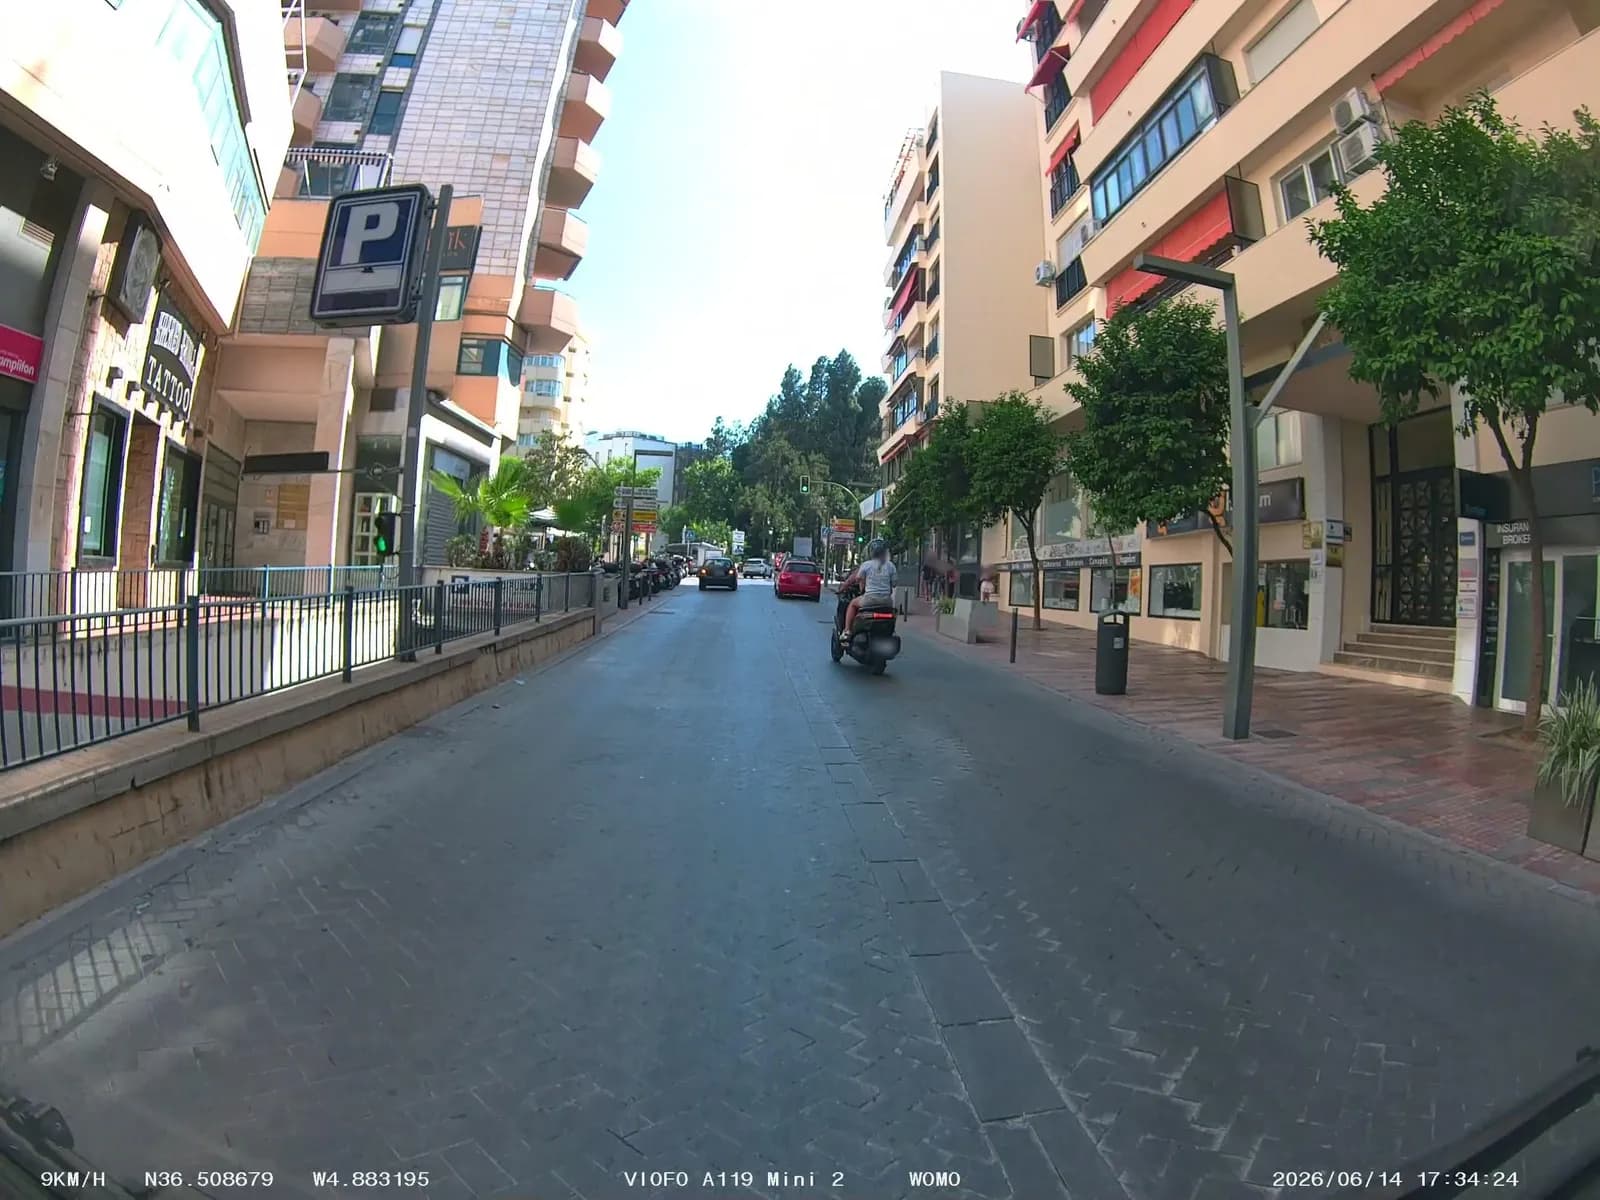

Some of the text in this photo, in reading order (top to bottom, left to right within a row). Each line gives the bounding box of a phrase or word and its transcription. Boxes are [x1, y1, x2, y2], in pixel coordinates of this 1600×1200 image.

[340, 202, 399, 265] P
[146, 355, 190, 411] TATTOO
[1497, 521, 1529, 533] INSURAN
